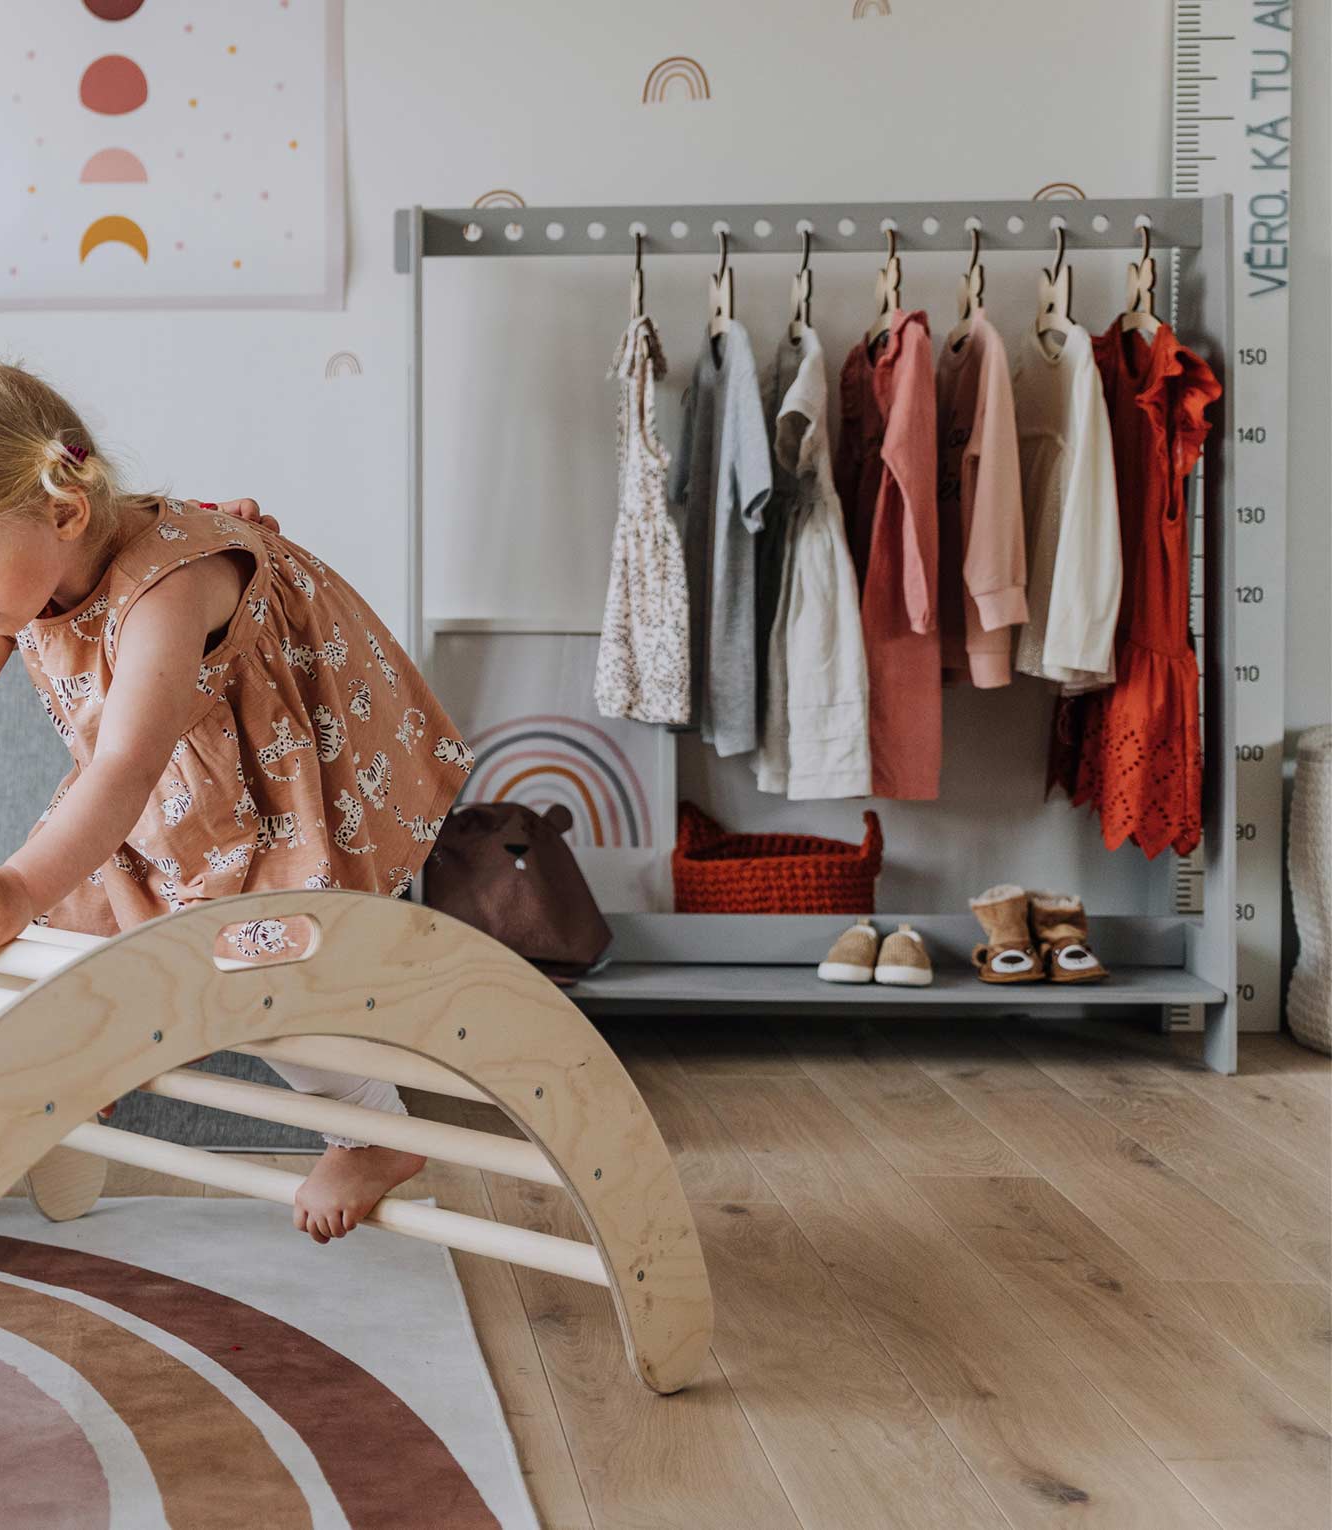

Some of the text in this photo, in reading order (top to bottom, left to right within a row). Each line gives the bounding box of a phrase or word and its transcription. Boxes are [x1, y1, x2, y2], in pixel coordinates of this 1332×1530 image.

[1250, 50, 1290, 100] TU
[1237, 348, 1267, 366] 150
[1237, 426, 1266, 444] 140
[1236, 506, 1266, 524] 130
[1235, 586, 1264, 604] 120
[1233, 665, 1260, 683] 110
[1235, 743, 1264, 761] 100
